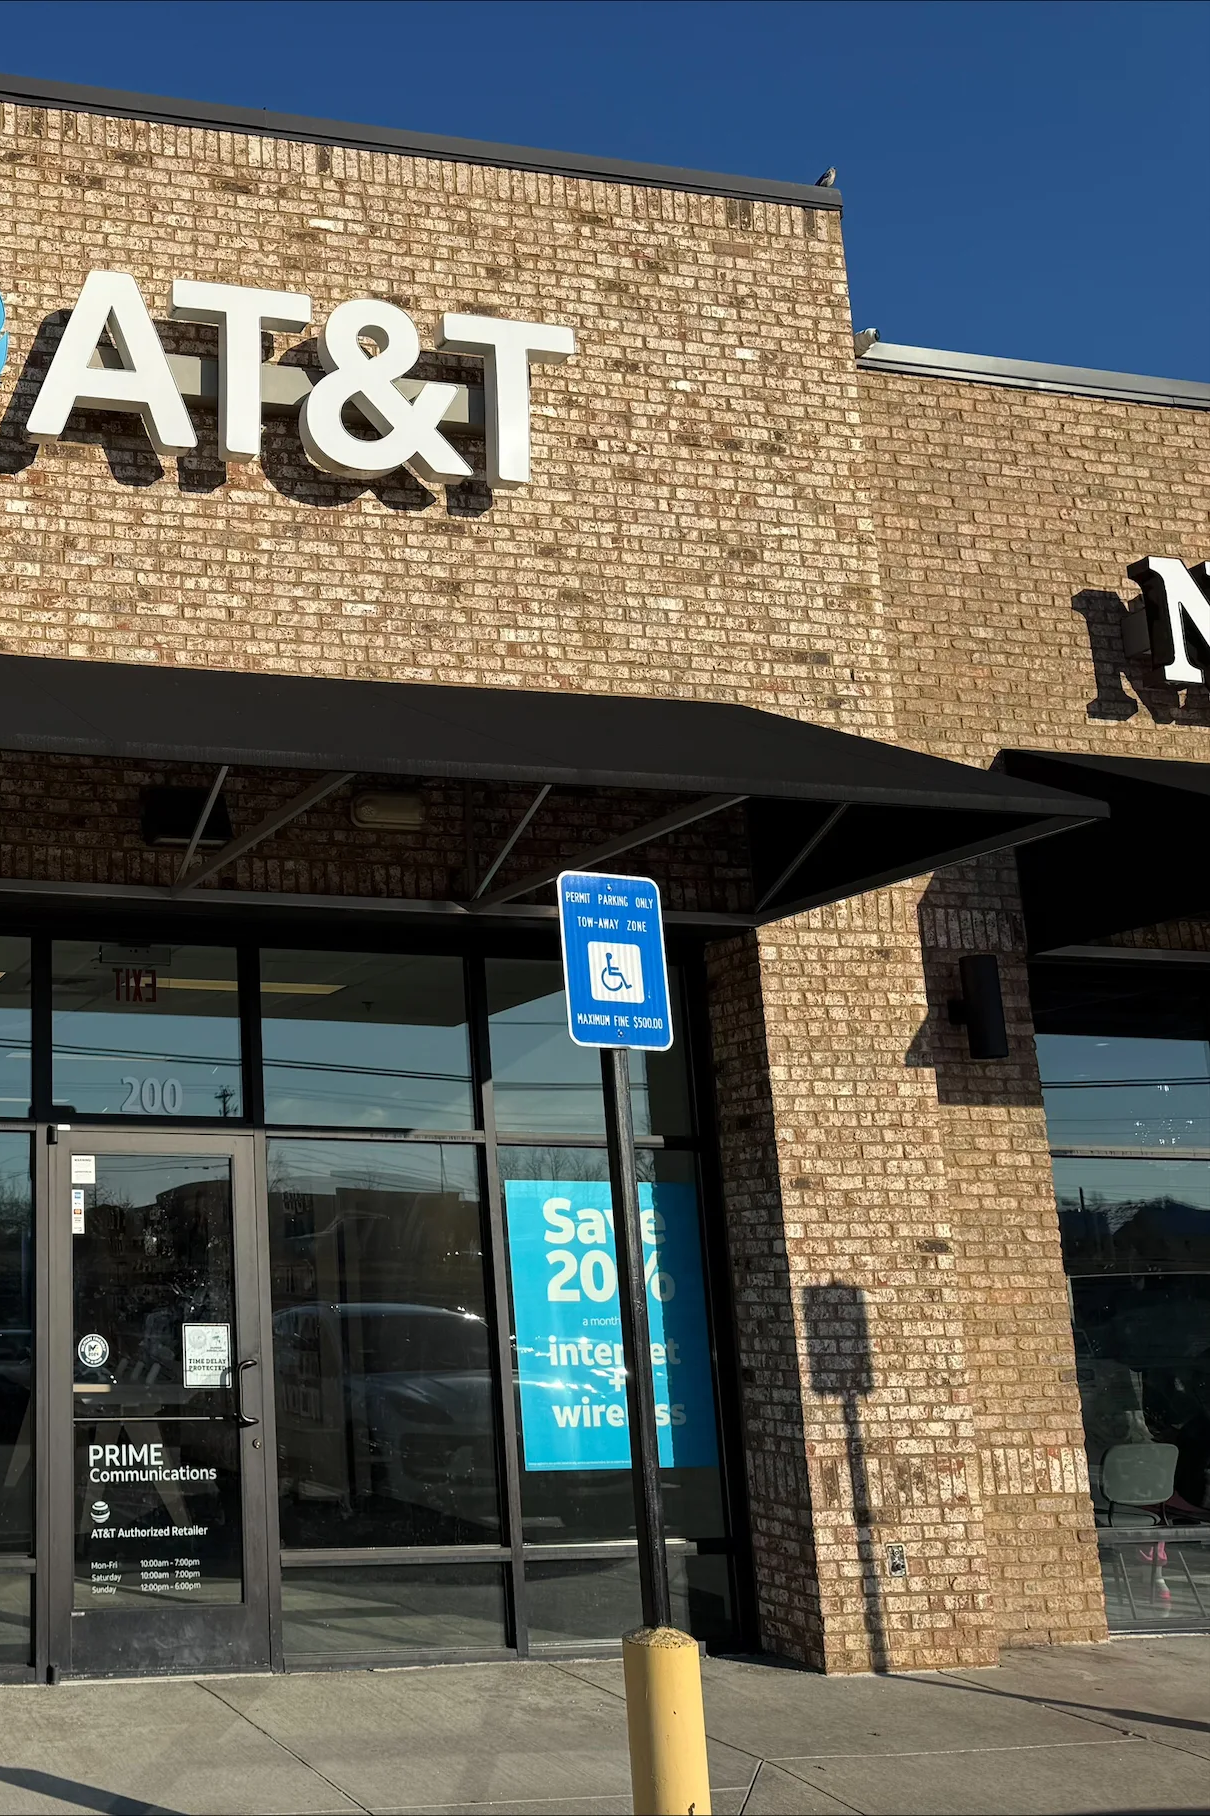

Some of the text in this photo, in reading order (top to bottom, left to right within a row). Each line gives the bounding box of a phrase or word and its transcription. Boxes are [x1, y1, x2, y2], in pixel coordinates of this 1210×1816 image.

[26, 269, 576, 490] AT&T
[565, 891, 654, 909] PERMIT PARKING ONLY
[577, 916, 647, 932] TOW-AWAY ZONE
[577, 1013, 663, 1029] MAXIMUM FINE $500.00
[120, 1076, 184, 1114] 200
[582, 1316, 621, 1326] a month
[548, 1334, 682, 1366] interet
[552, 1396, 688, 1428] wiress
[88, 1443, 164, 1467] PRIME
[89, 1465, 218, 1483] Communications
[91, 1525, 208, 1539] AT&T Authorized Retailer
[91, 1561, 118, 1570] Mon-Fri
[140, 1559, 169, 1568] 10:00am
[174, 1558, 200, 1567] 7:00pm
[91, 1570, 200, 1583] Saturday 10:00am 7:00pm
[92, 1585, 117, 1594] Sunday
[140, 1583, 169, 1592] 12:00pm
[174, 1582, 201, 1591] 6:00pm
